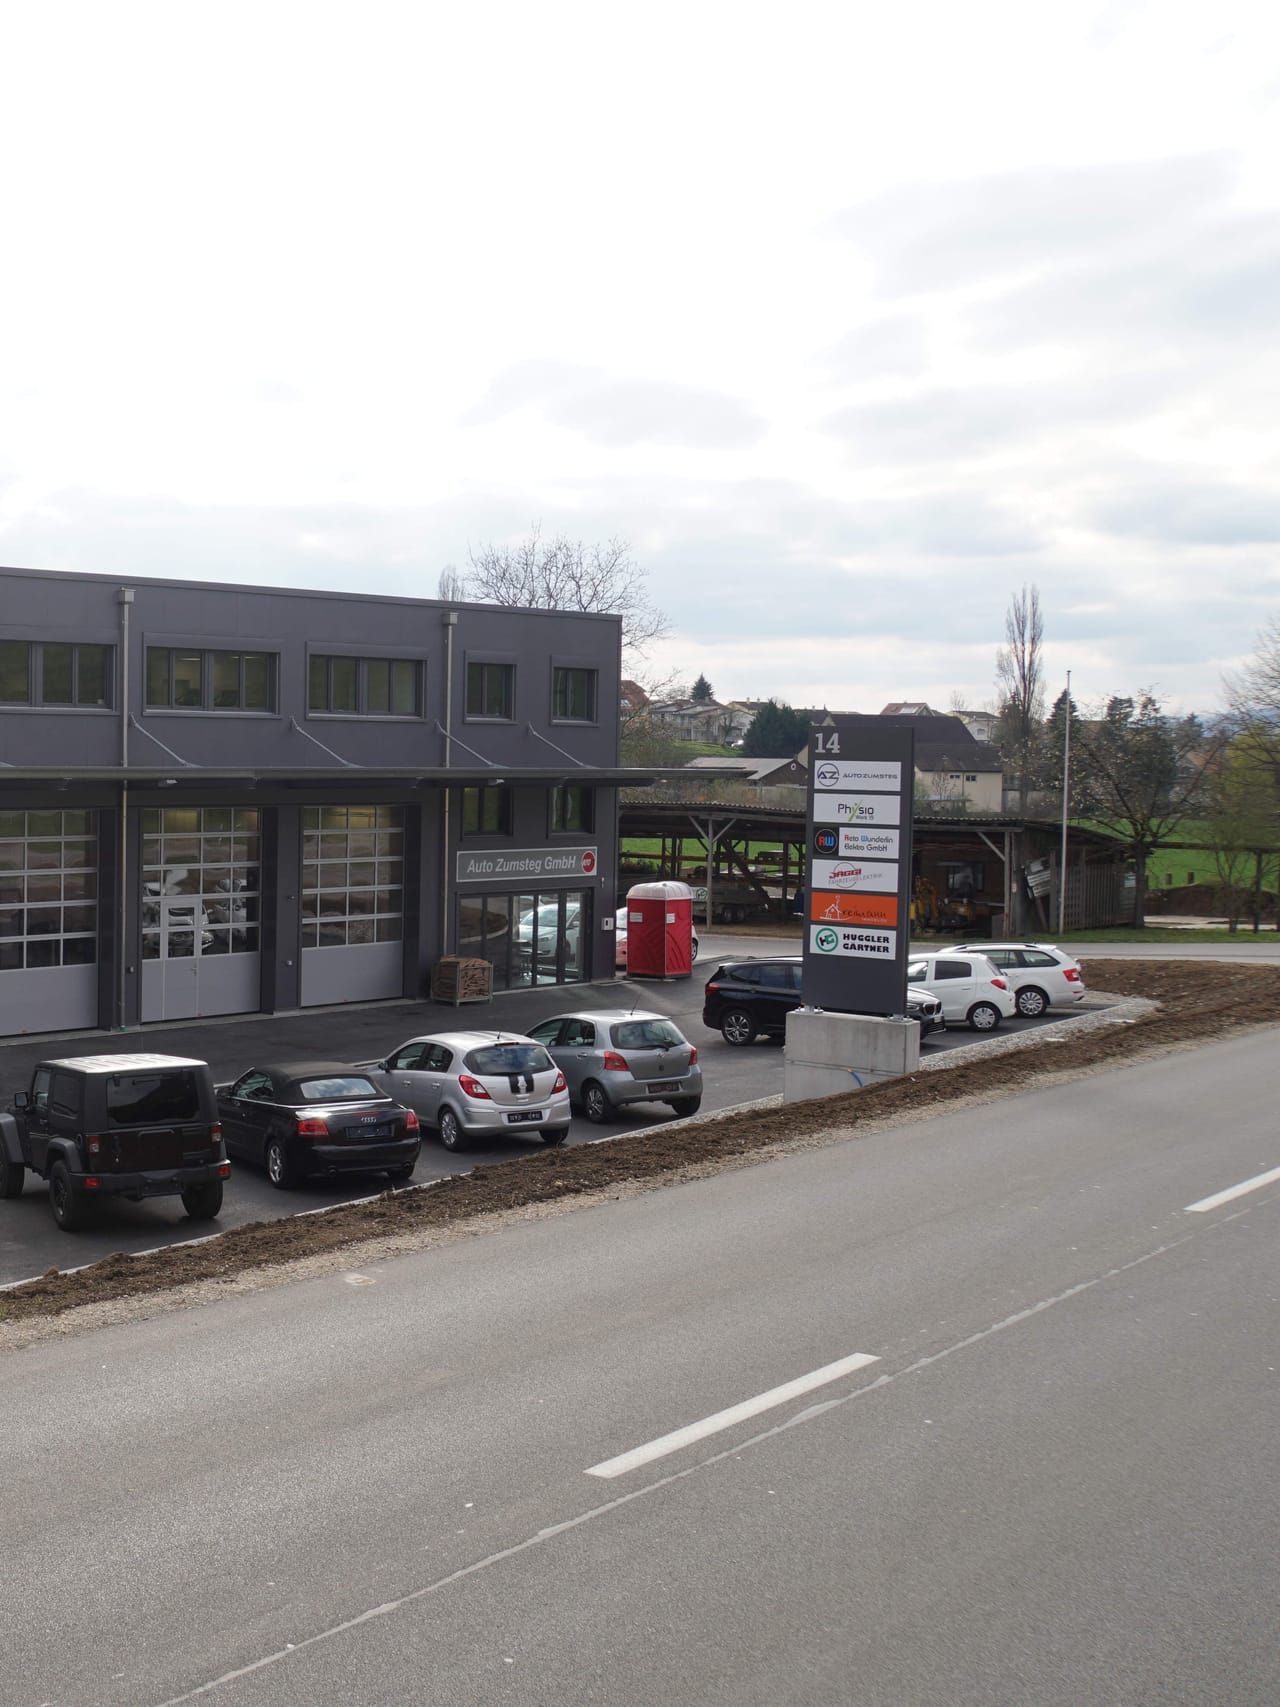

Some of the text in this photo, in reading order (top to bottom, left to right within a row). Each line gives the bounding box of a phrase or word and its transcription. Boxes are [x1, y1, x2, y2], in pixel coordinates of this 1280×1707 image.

[815, 732, 840, 754] 14
[860, 834, 894, 844] Wunderlin
[866, 844, 888, 852] GmbH
[467, 860, 493, 873] Auto
[495, 858, 541, 873] Zumsteg
[544, 855, 576, 870] GmbH
[843, 933, 890, 944] HUGGLER
